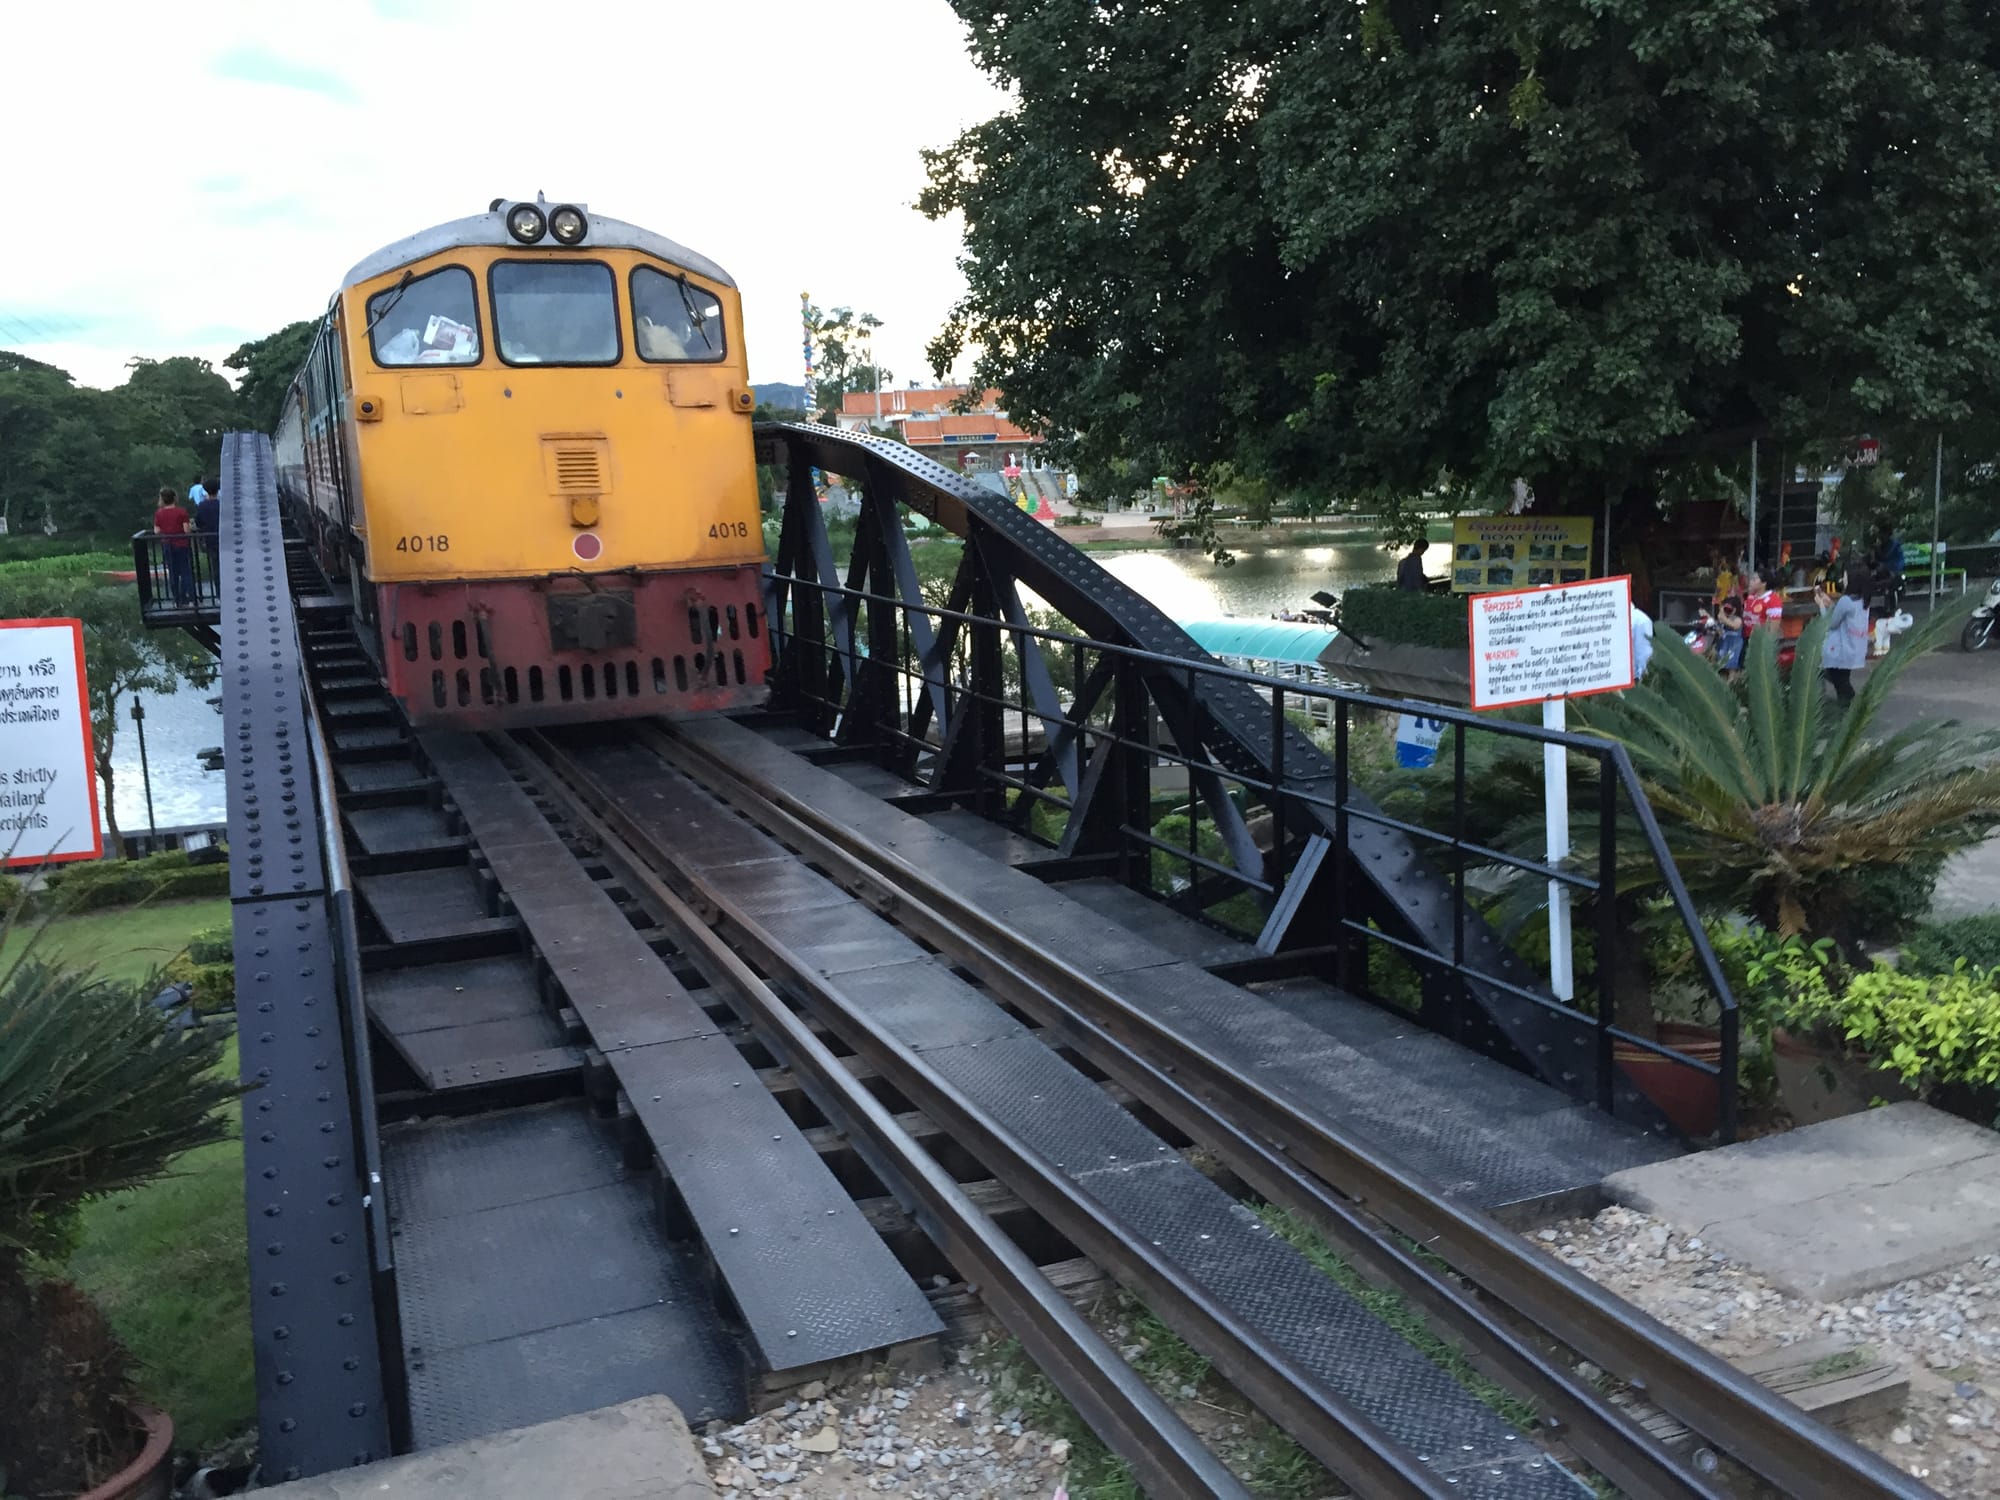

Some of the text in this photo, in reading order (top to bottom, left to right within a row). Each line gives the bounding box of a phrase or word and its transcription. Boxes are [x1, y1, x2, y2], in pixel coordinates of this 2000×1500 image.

[708, 522, 748, 539] 4018
[1480, 533, 1568, 541] BOAT TRIP
[396, 535, 449, 553] 4018
[1484, 648, 1520, 661] WARNING
[28, 656, 56, 677] หรือ
[1488, 661, 1507, 674] bridge
[1488, 673, 1522, 687] approaches
[1524, 669, 1542, 682] bridge
[12, 767, 57, 785] strictly
